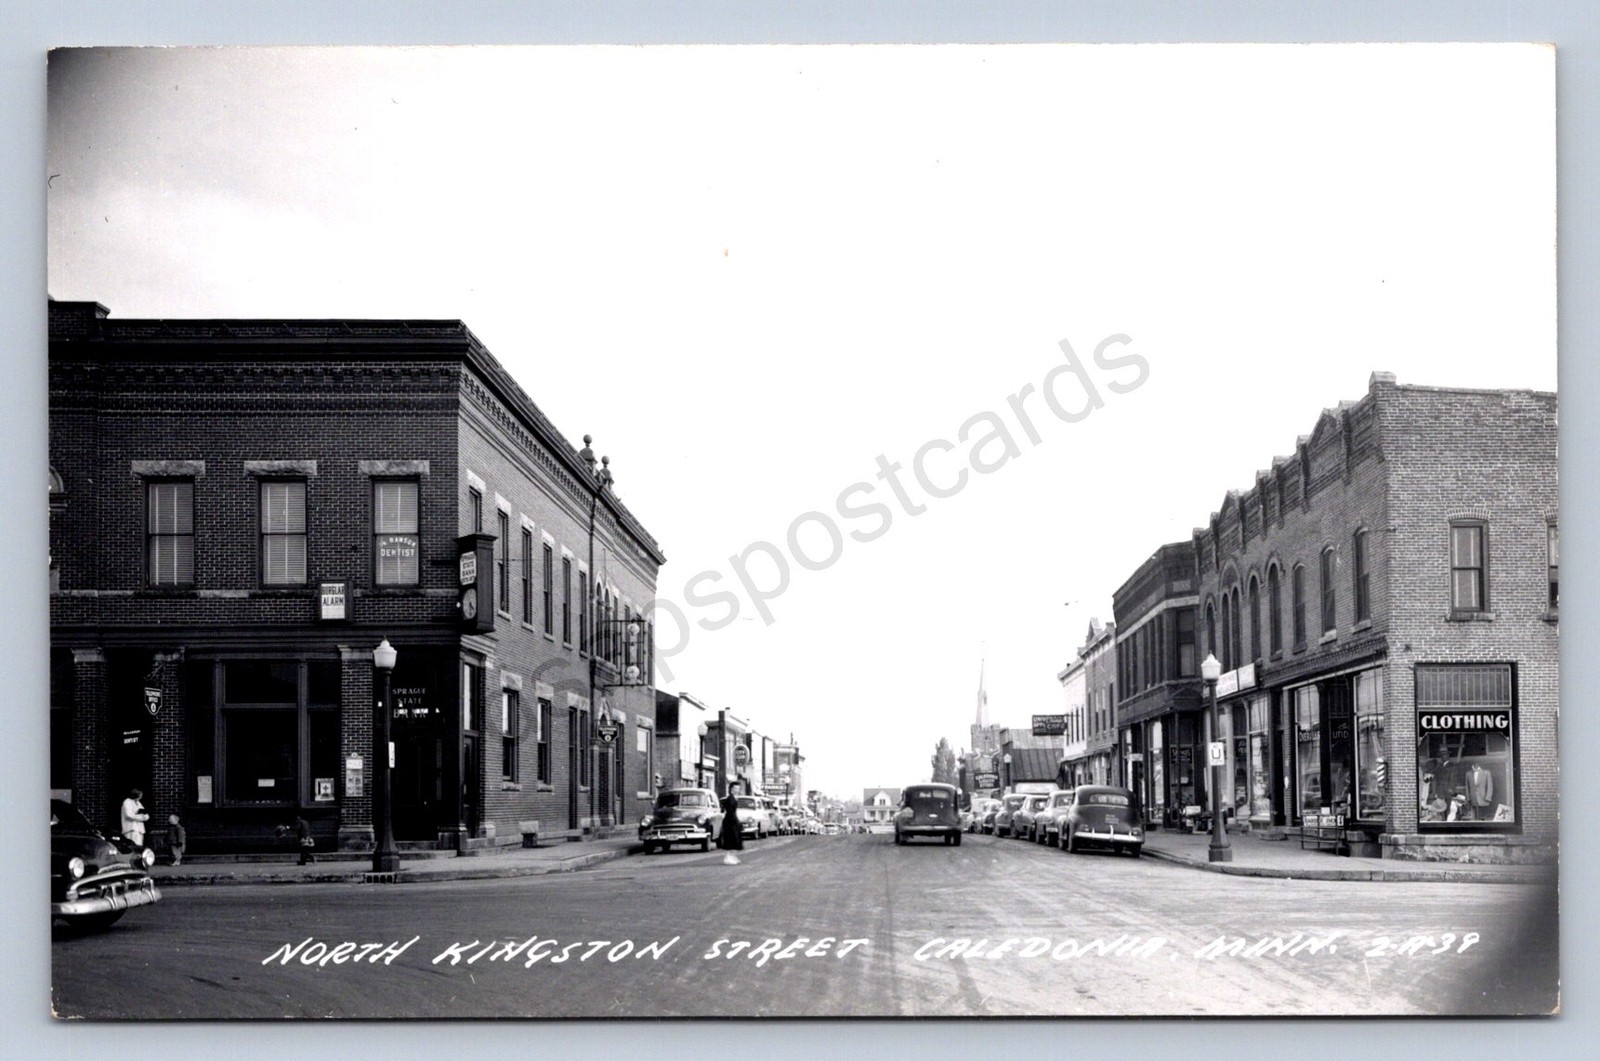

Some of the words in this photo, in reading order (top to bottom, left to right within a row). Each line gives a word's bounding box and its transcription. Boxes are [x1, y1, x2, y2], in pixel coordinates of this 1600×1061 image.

[380, 548, 415, 557] DENTIST
[462, 569, 475, 577] BANK
[321, 585, 345, 595] BURGLAR
[322, 596, 345, 606] ALARM
[1421, 715, 1509, 729] CLOTHING
